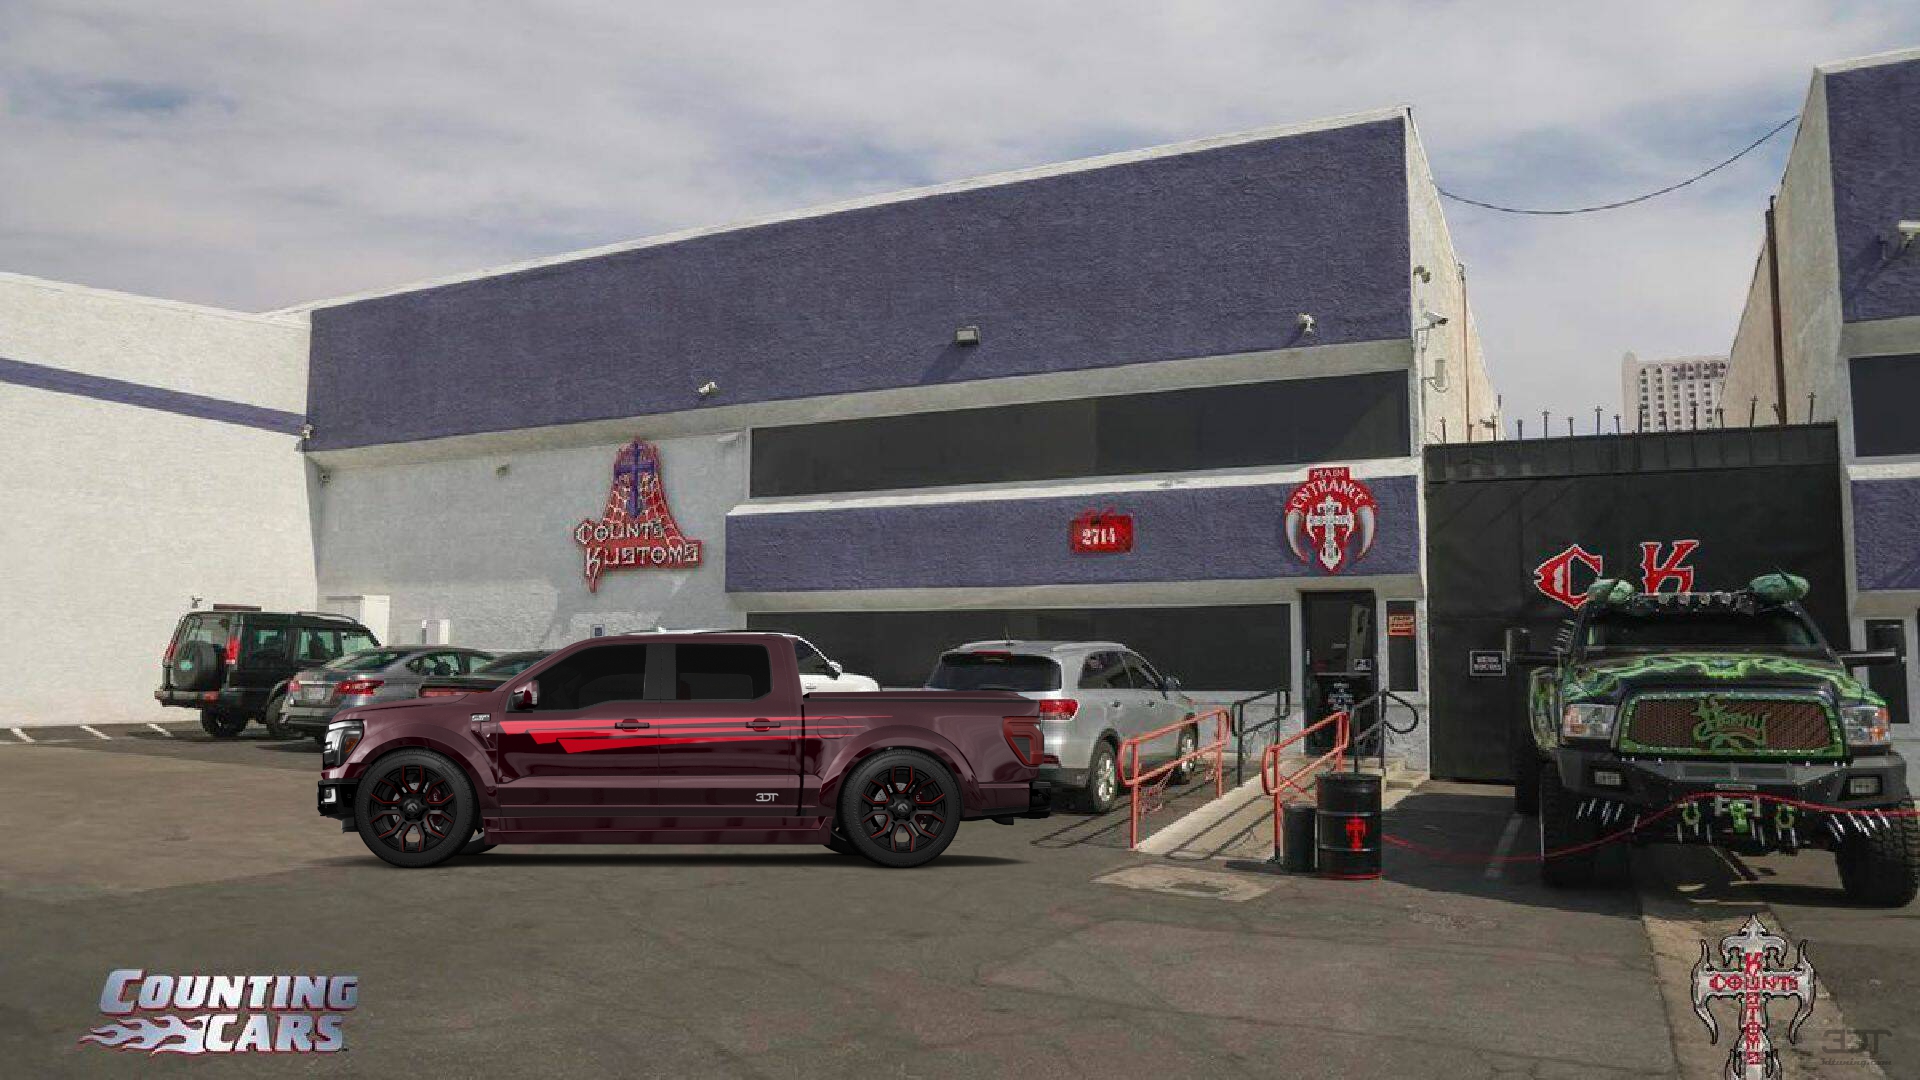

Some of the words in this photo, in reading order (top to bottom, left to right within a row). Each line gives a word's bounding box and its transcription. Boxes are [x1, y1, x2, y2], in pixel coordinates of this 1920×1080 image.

[1313, 469, 1345, 479] MAIN
[1292, 479, 1368, 508] ENTRANCE
[1081, 527, 1116, 545] 2714
[585, 543, 699, 591] KUSTOMS
[1534, 543, 1603, 609] C
[1640, 540, 1700, 595] K
[755, 792, 780, 802] 3DT
